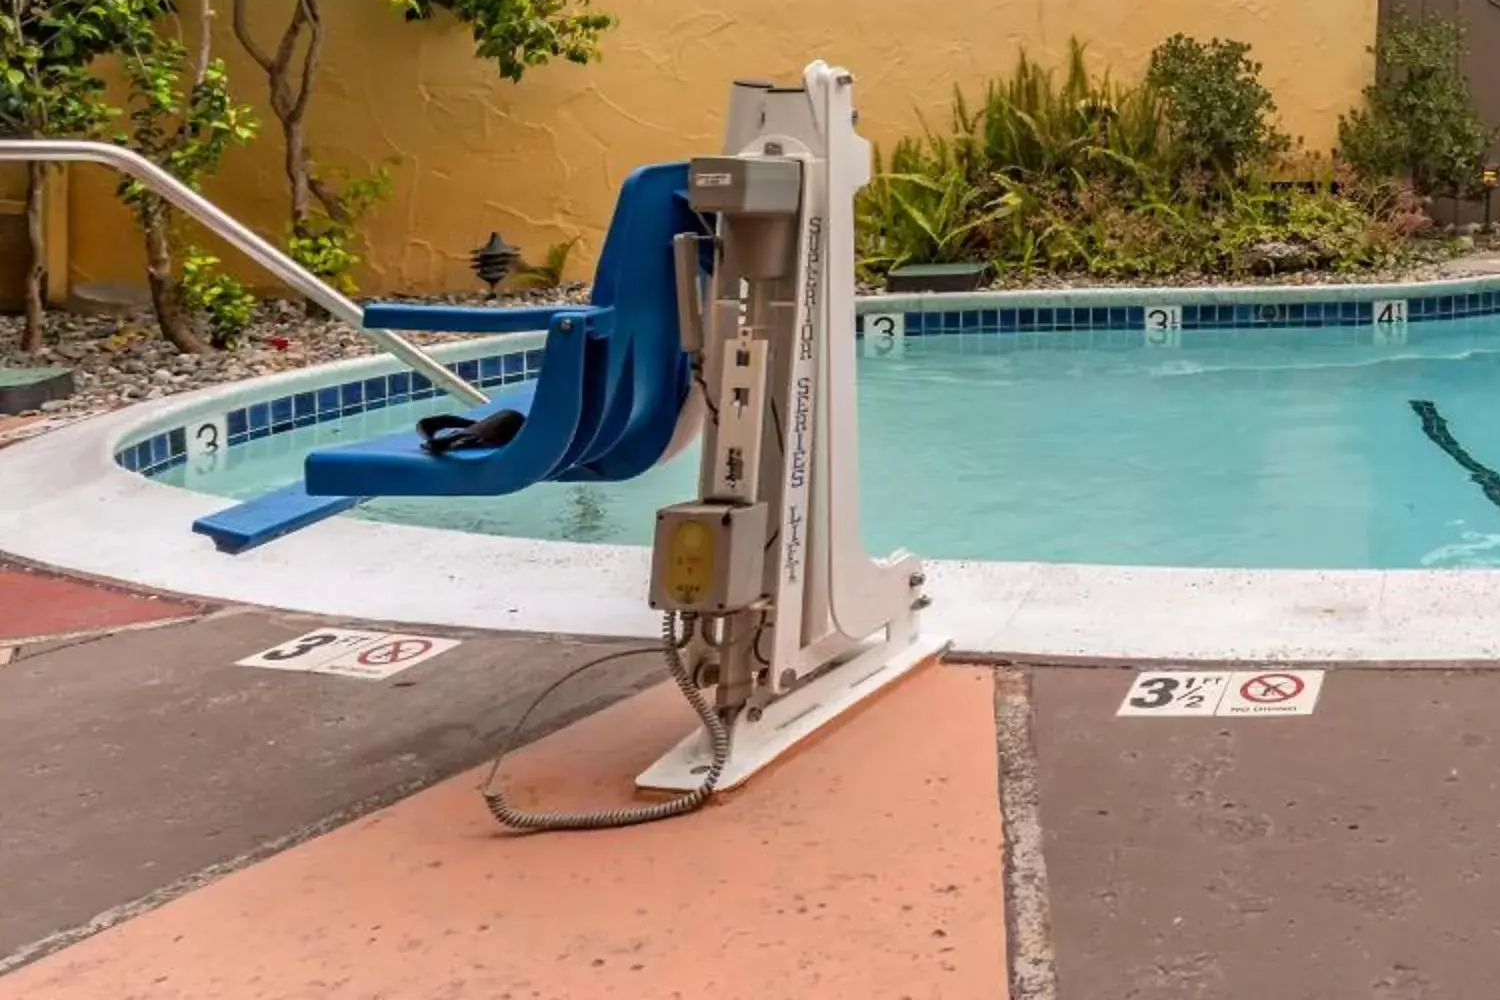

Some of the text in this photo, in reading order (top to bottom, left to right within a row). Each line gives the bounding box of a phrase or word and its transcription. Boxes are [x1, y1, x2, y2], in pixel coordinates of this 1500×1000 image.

[800, 216, 822, 361] SUPERIOR
[873, 316, 895, 337] 3
[196, 423, 219, 451] 3
[791, 377, 811, 489] SERIES
[262, 633, 337, 661] 3
